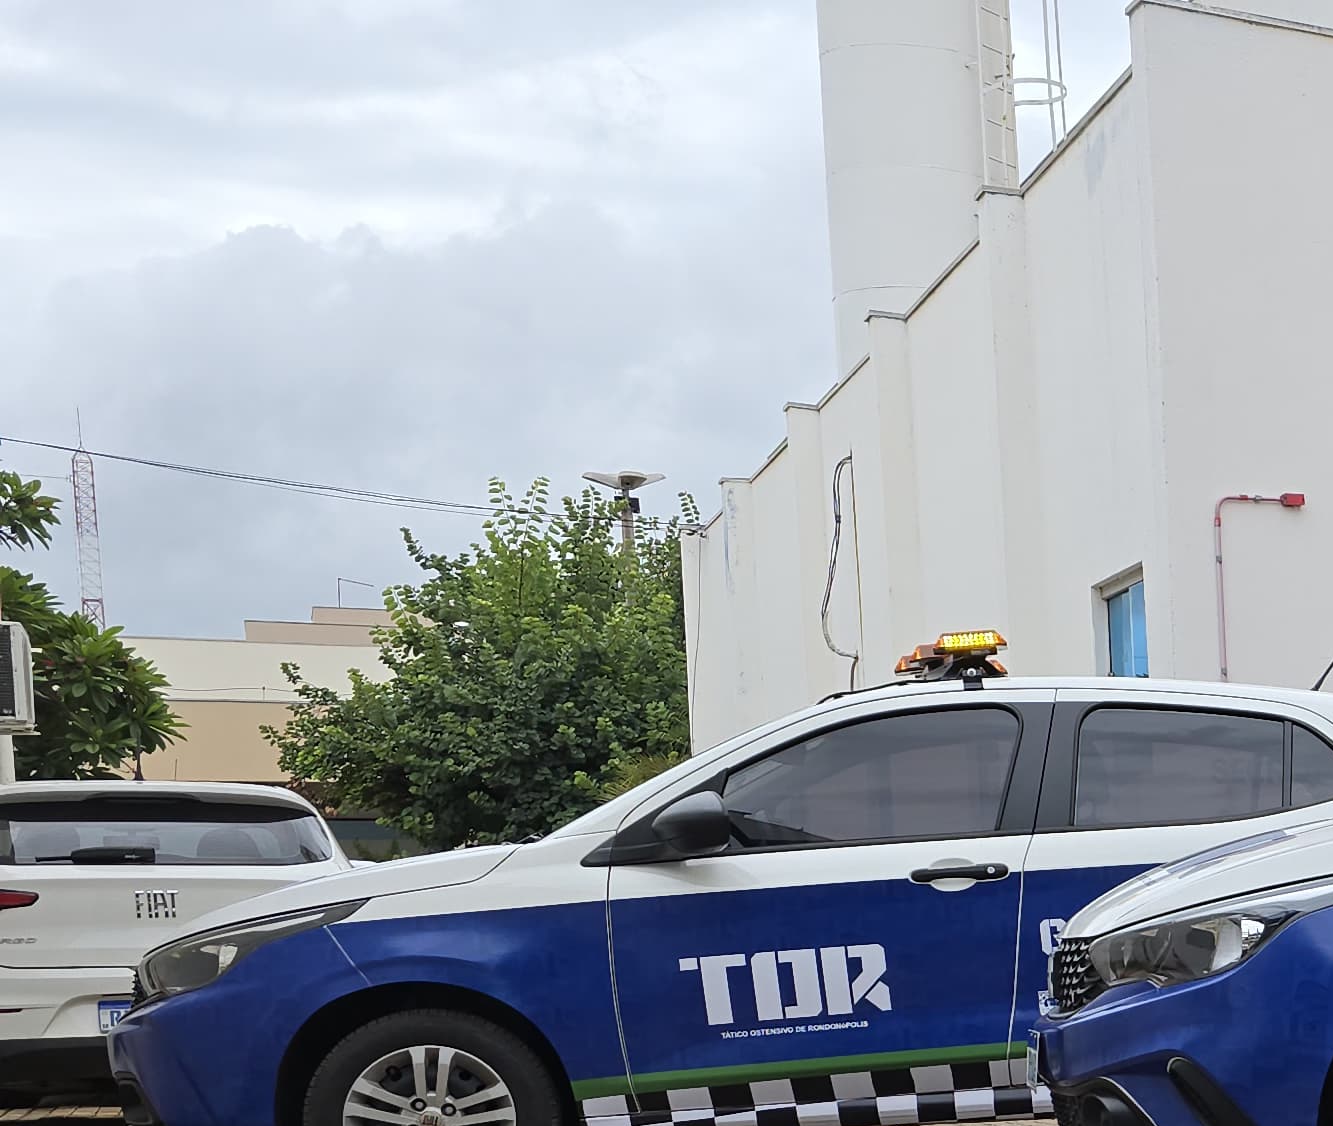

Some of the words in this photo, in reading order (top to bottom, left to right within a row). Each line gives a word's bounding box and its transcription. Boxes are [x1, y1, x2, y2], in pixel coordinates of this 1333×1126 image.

[134, 889, 179, 919] FIAT
[678, 943, 893, 1026] TOR
[720, 1029, 748, 1039] TÁTICO
[750, 1026, 794, 1038] OSTENSIVO
[795, 1025, 806, 1033] DE
